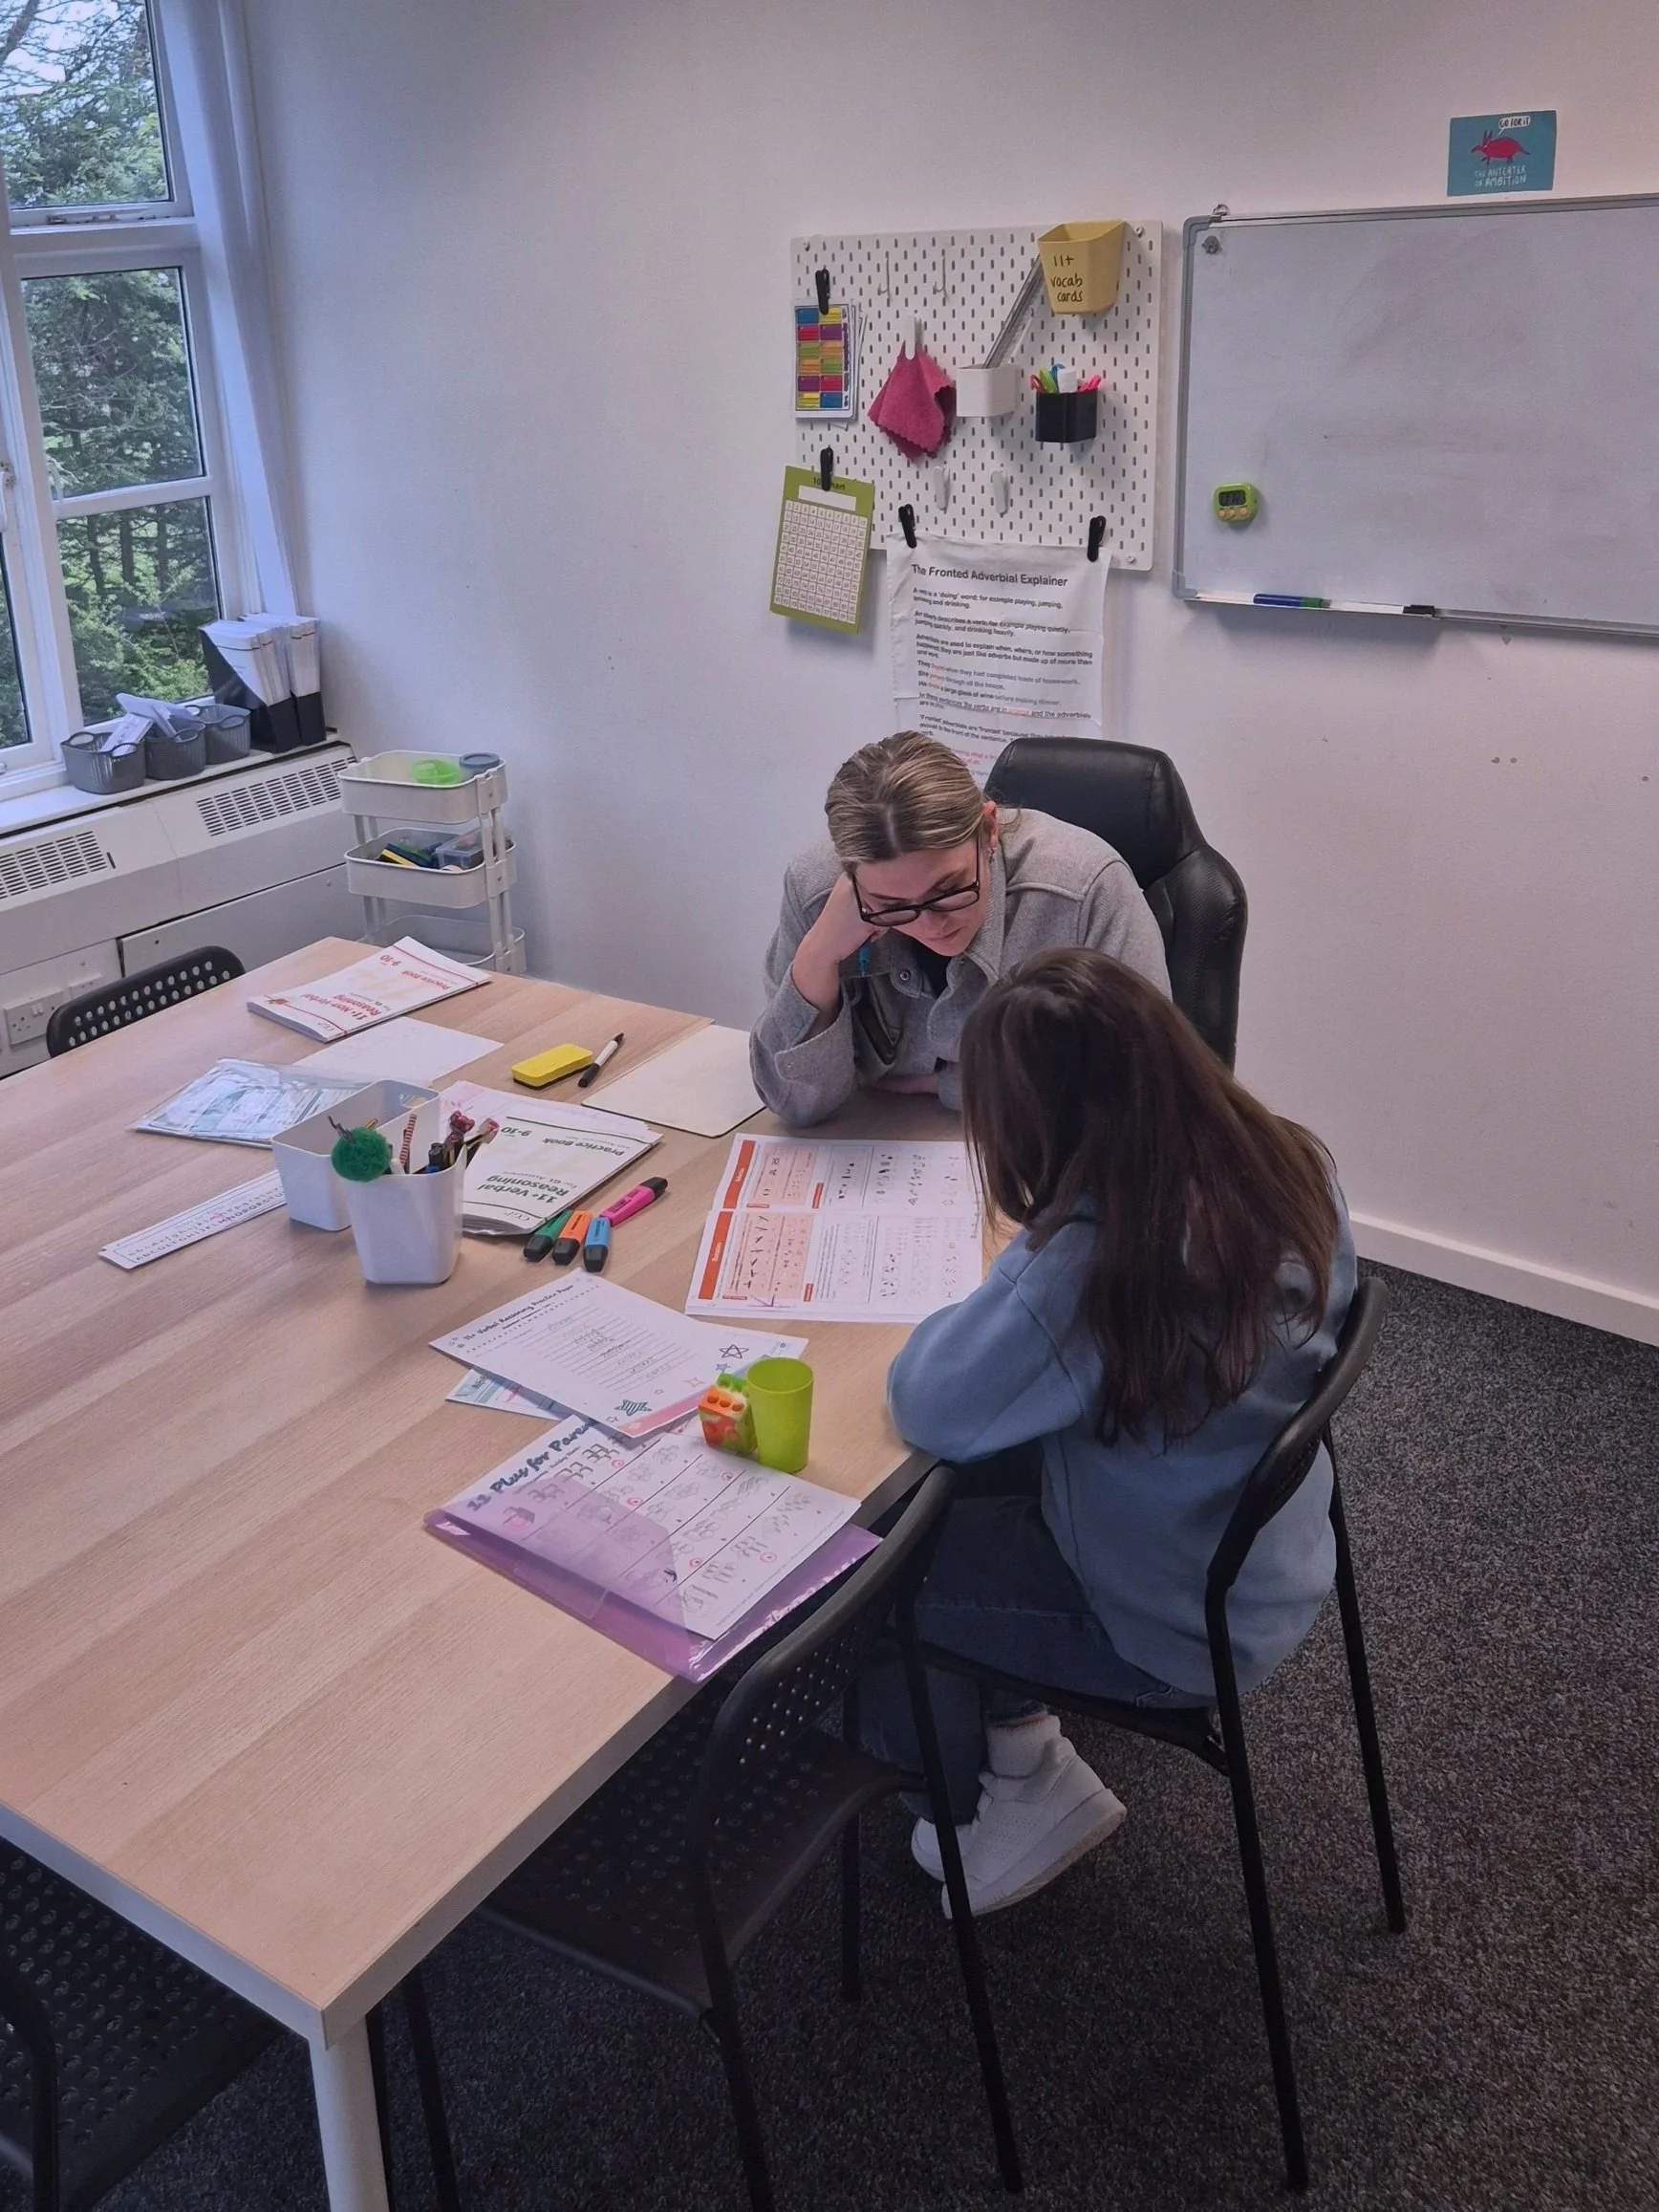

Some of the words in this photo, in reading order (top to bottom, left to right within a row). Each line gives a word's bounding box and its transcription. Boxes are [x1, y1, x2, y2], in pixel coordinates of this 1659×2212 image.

[1487, 164, 1526, 178] ANTEATER
[1053, 254, 1074, 268] 11+
[1051, 271, 1083, 289] vocab
[1057, 291, 1083, 302] cards
[912, 564, 927, 575] The
[929, 566, 969, 579] Fronted
[971, 570, 1019, 583] Adverbial
[1021, 574, 1068, 587] Explainer
[967, 626, 992, 635] drinking
[1057, 650, 1093, 659] something
[380, 954, 401, 967] 9-10
[420, 977, 452, 990] Practice
[333, 994, 381, 1017] Reasoning
[501, 1126, 532, 1138] 9-10
[543, 1137, 573, 1147] Book
[575, 1141, 625, 1157] Practice
[476, 1183, 530, 1197] Verbal
[485, 1174, 570, 1196] Reasoning
[531, 1193, 558, 1204] 11+
[489, 1466, 529, 1493] Plus
[527, 1451, 550, 1473] for
